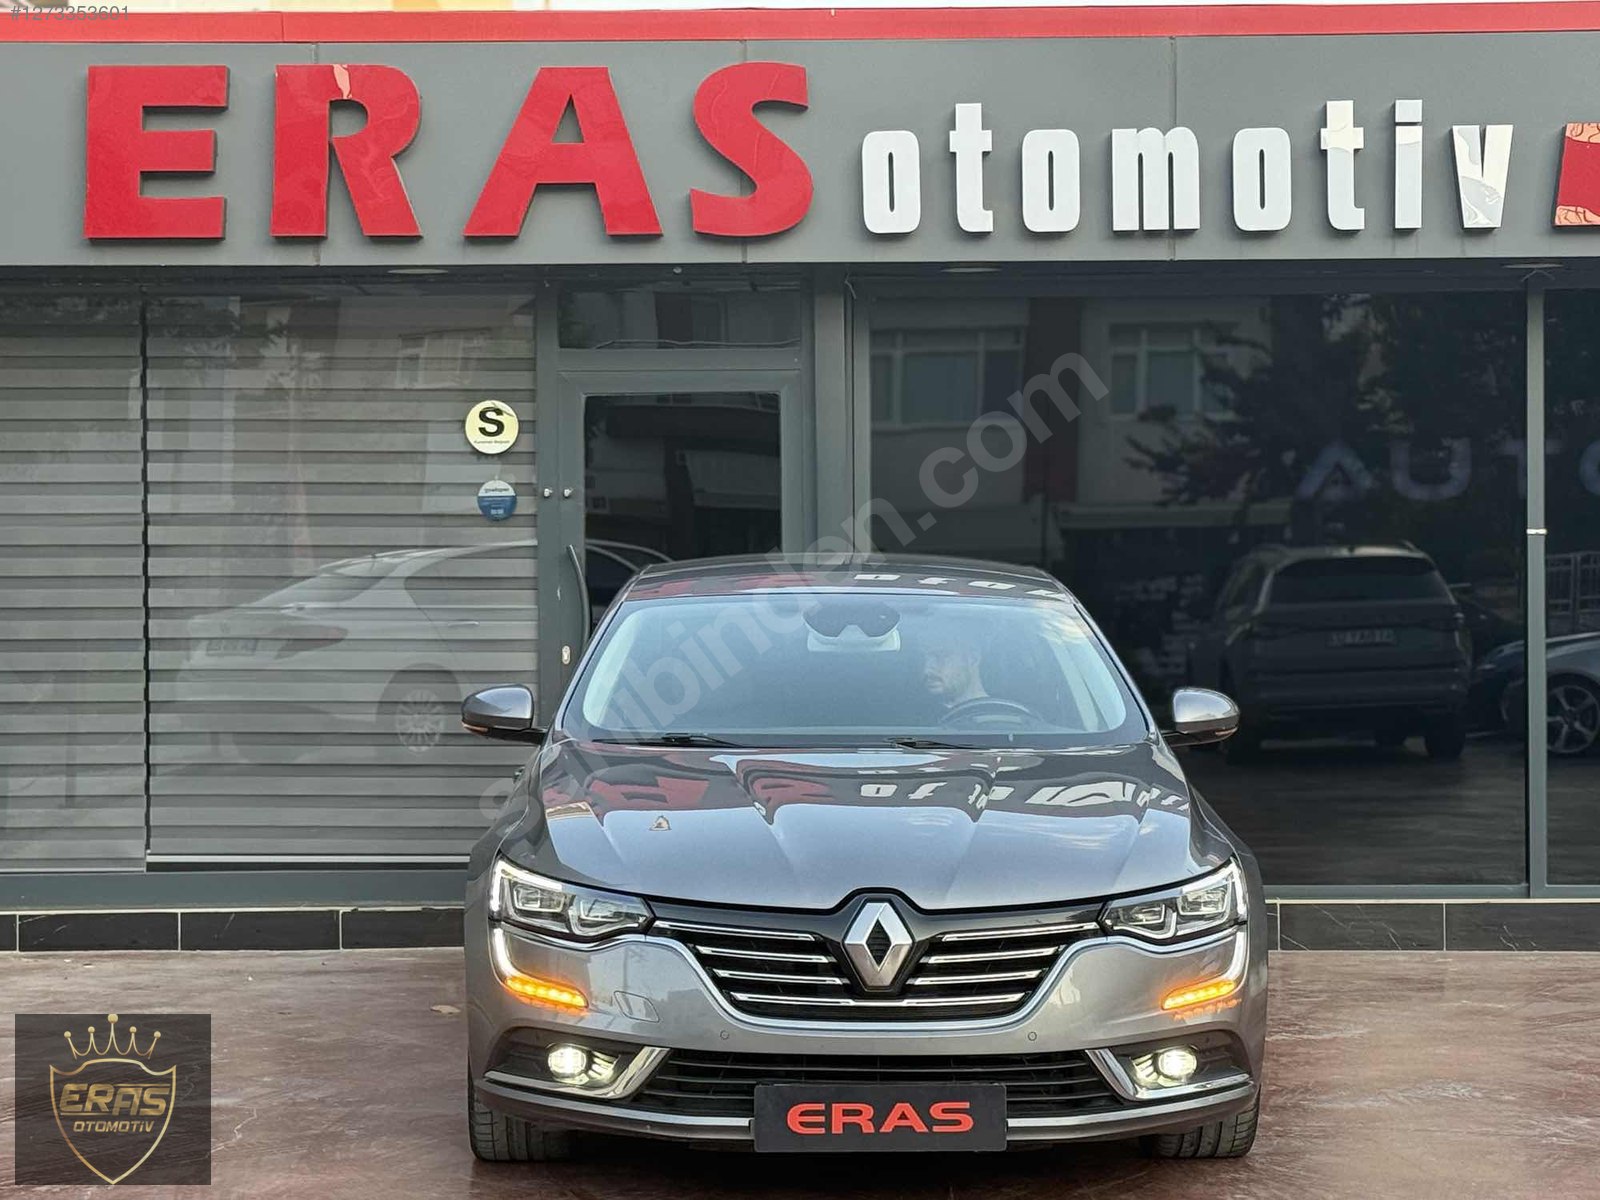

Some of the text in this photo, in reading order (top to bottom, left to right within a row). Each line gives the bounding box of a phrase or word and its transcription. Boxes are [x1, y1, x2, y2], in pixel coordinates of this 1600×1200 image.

[84, 62, 1515, 240] ERAS otomotiv
[478, 406, 505, 438] S
[786, 1101, 975, 1135] ERAS
